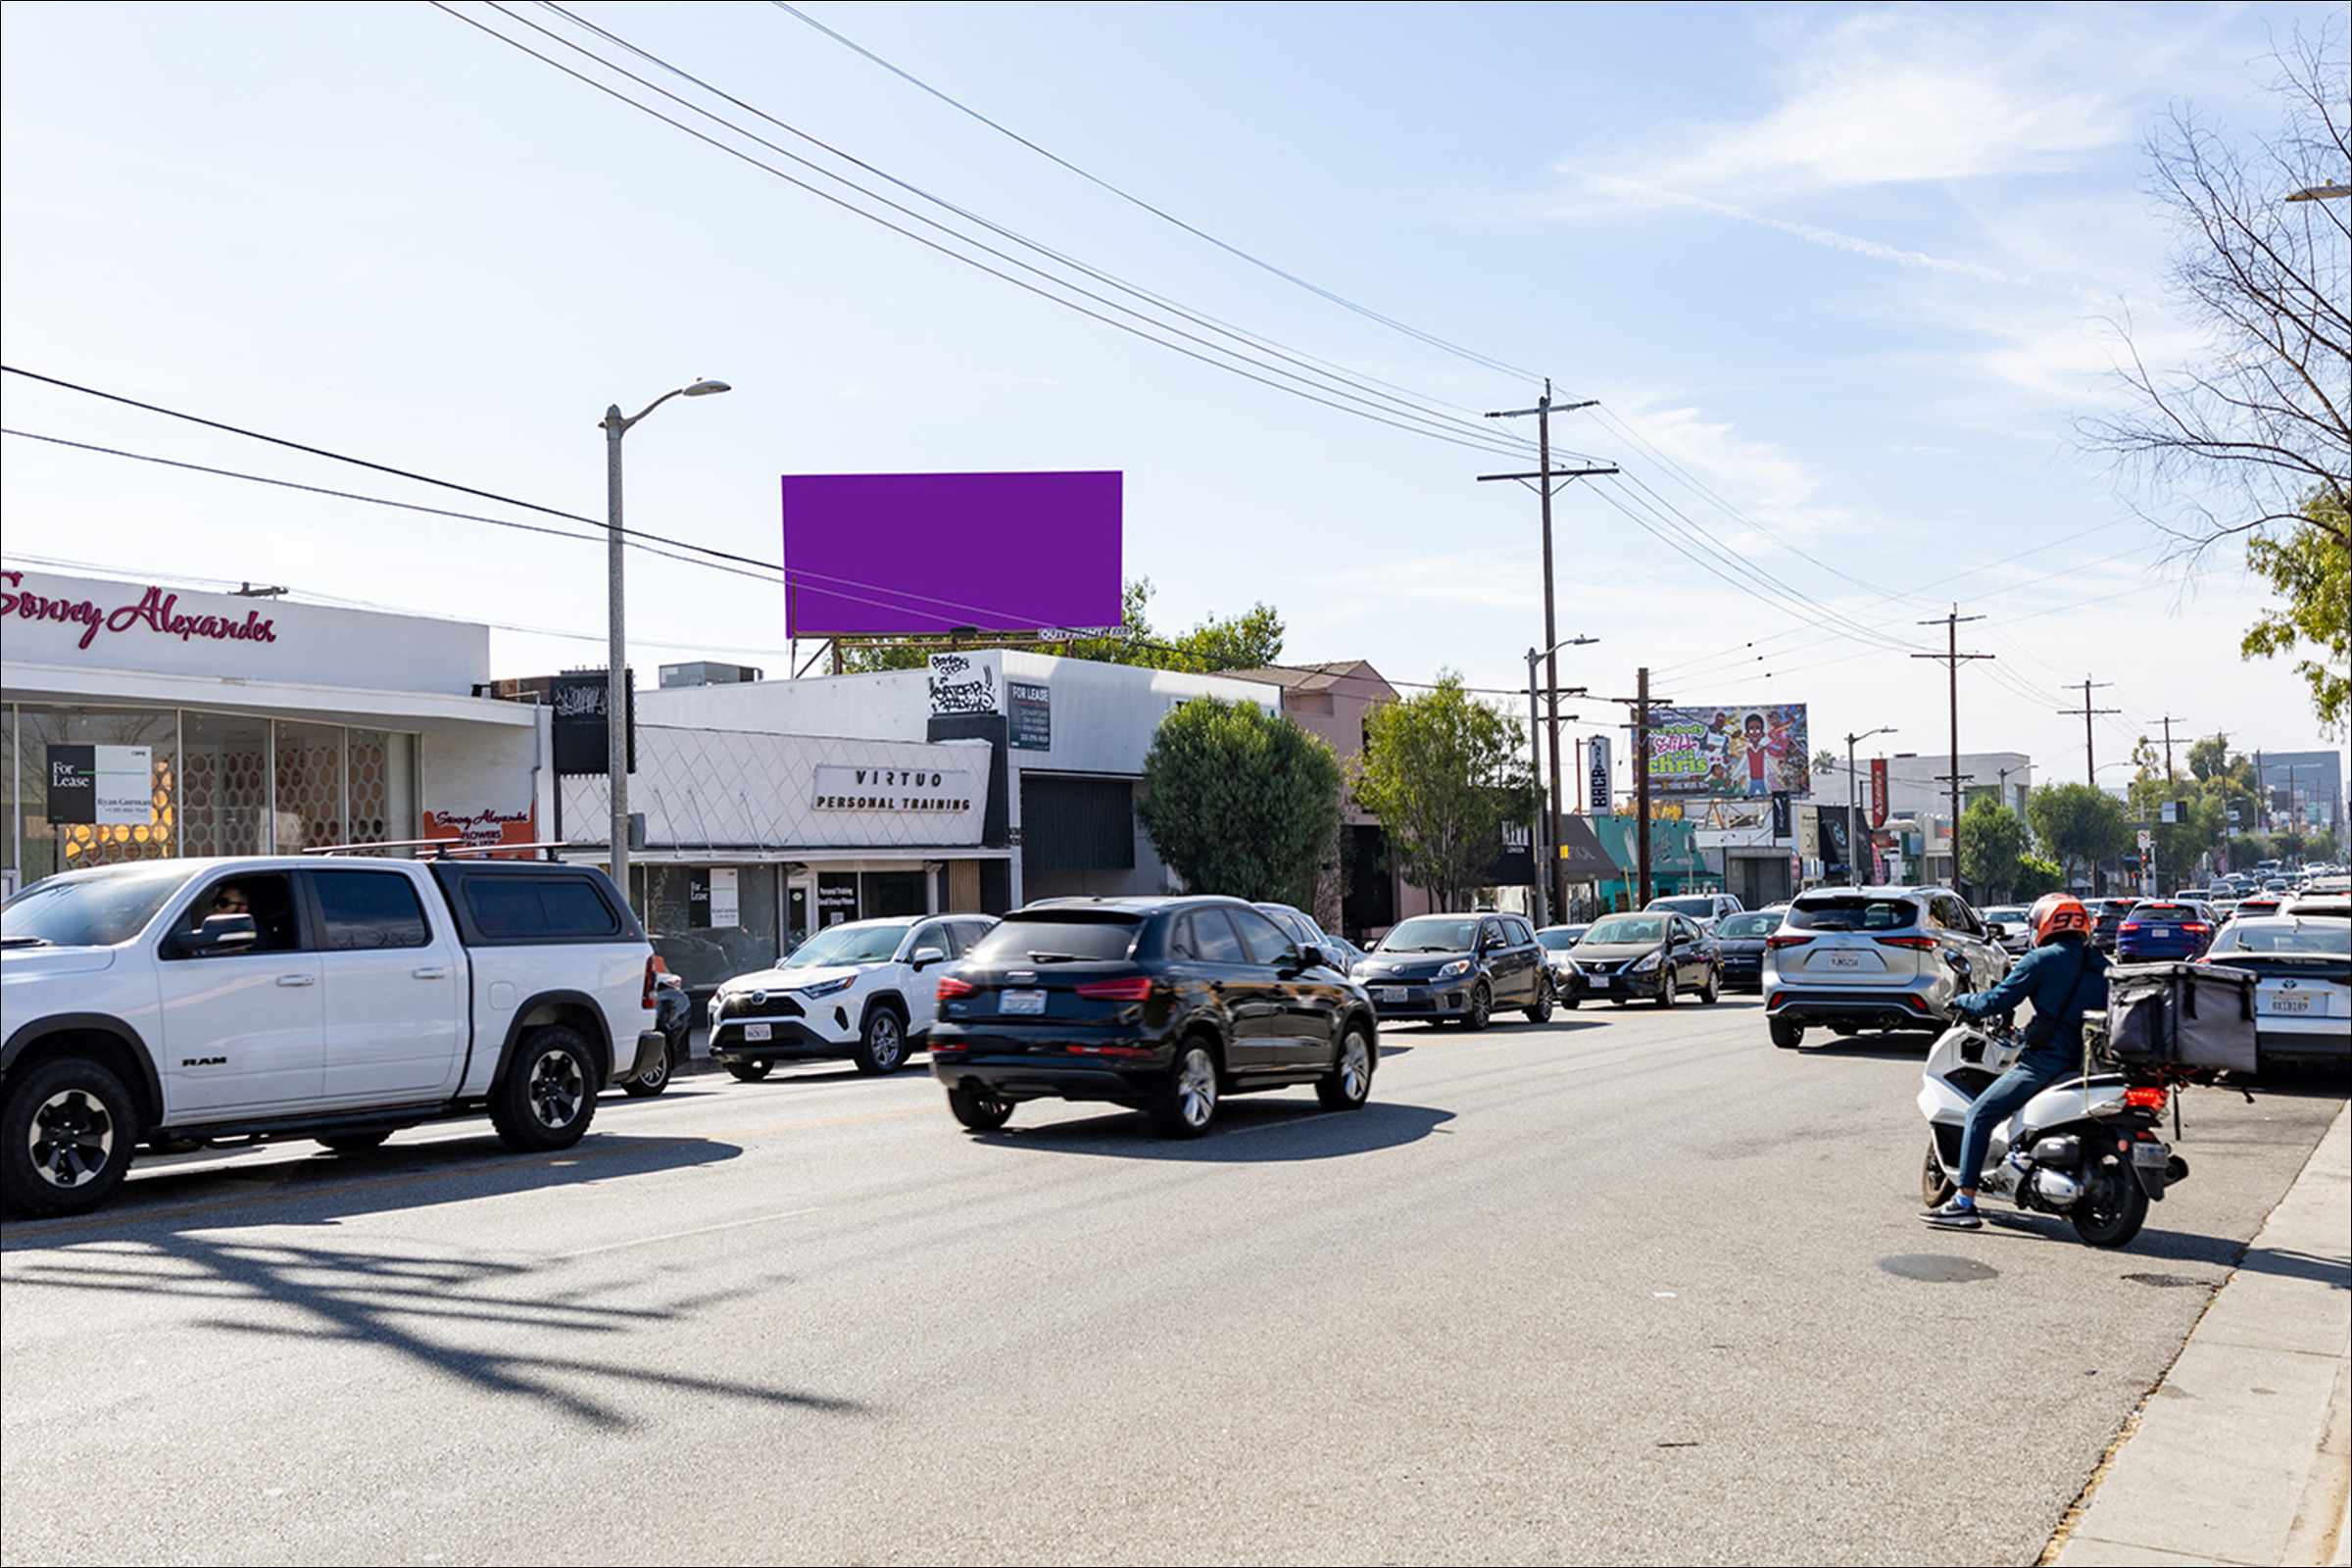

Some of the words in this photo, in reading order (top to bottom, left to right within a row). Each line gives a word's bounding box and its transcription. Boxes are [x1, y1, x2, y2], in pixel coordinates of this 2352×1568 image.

[1, 571, 105, 650] Sonny
[107, 586, 276, 643] Alexander
[1012, 686, 1026, 699] FOR
[1027, 687, 1049, 702] LEASE
[1649, 723, 1705, 736] verybody
[53, 761, 74, 774] For
[1648, 755, 1708, 773] chris
[53, 774, 90, 788] Lease
[816, 796, 895, 809] PERSONAL
[902, 797, 970, 810] TRAINING
[2052, 911, 2086, 931] 93
[182, 1056, 227, 1067] RAM
